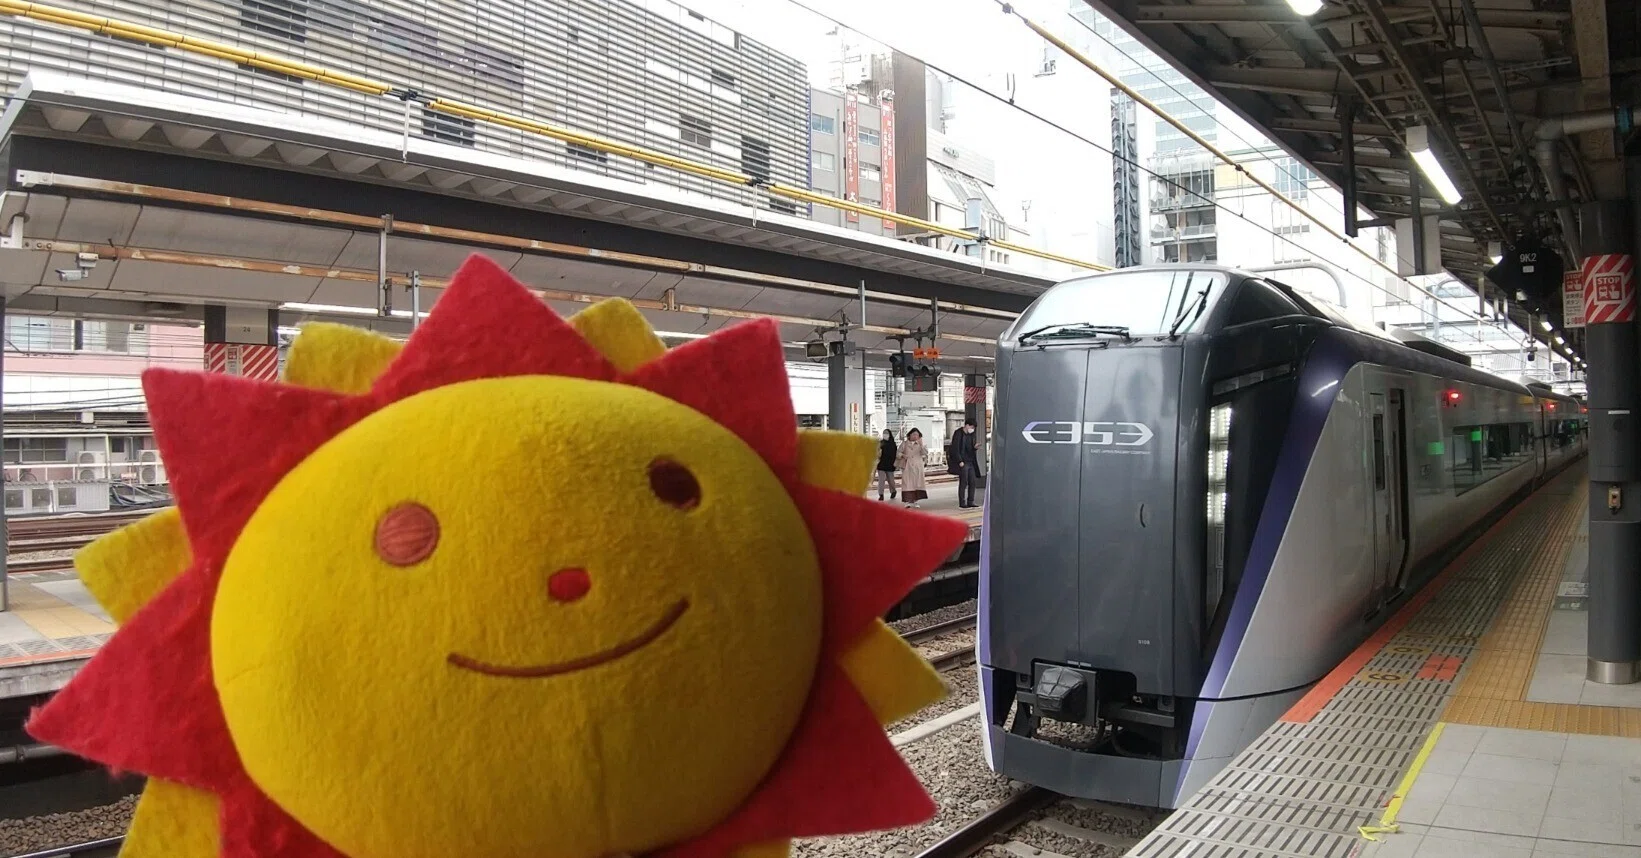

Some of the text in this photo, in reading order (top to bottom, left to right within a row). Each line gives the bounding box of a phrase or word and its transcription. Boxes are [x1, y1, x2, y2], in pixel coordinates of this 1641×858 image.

[1519, 252, 1537, 263] 9K2
[1597, 277, 1620, 285] STOP
[1021, 421, 1154, 447] E353
